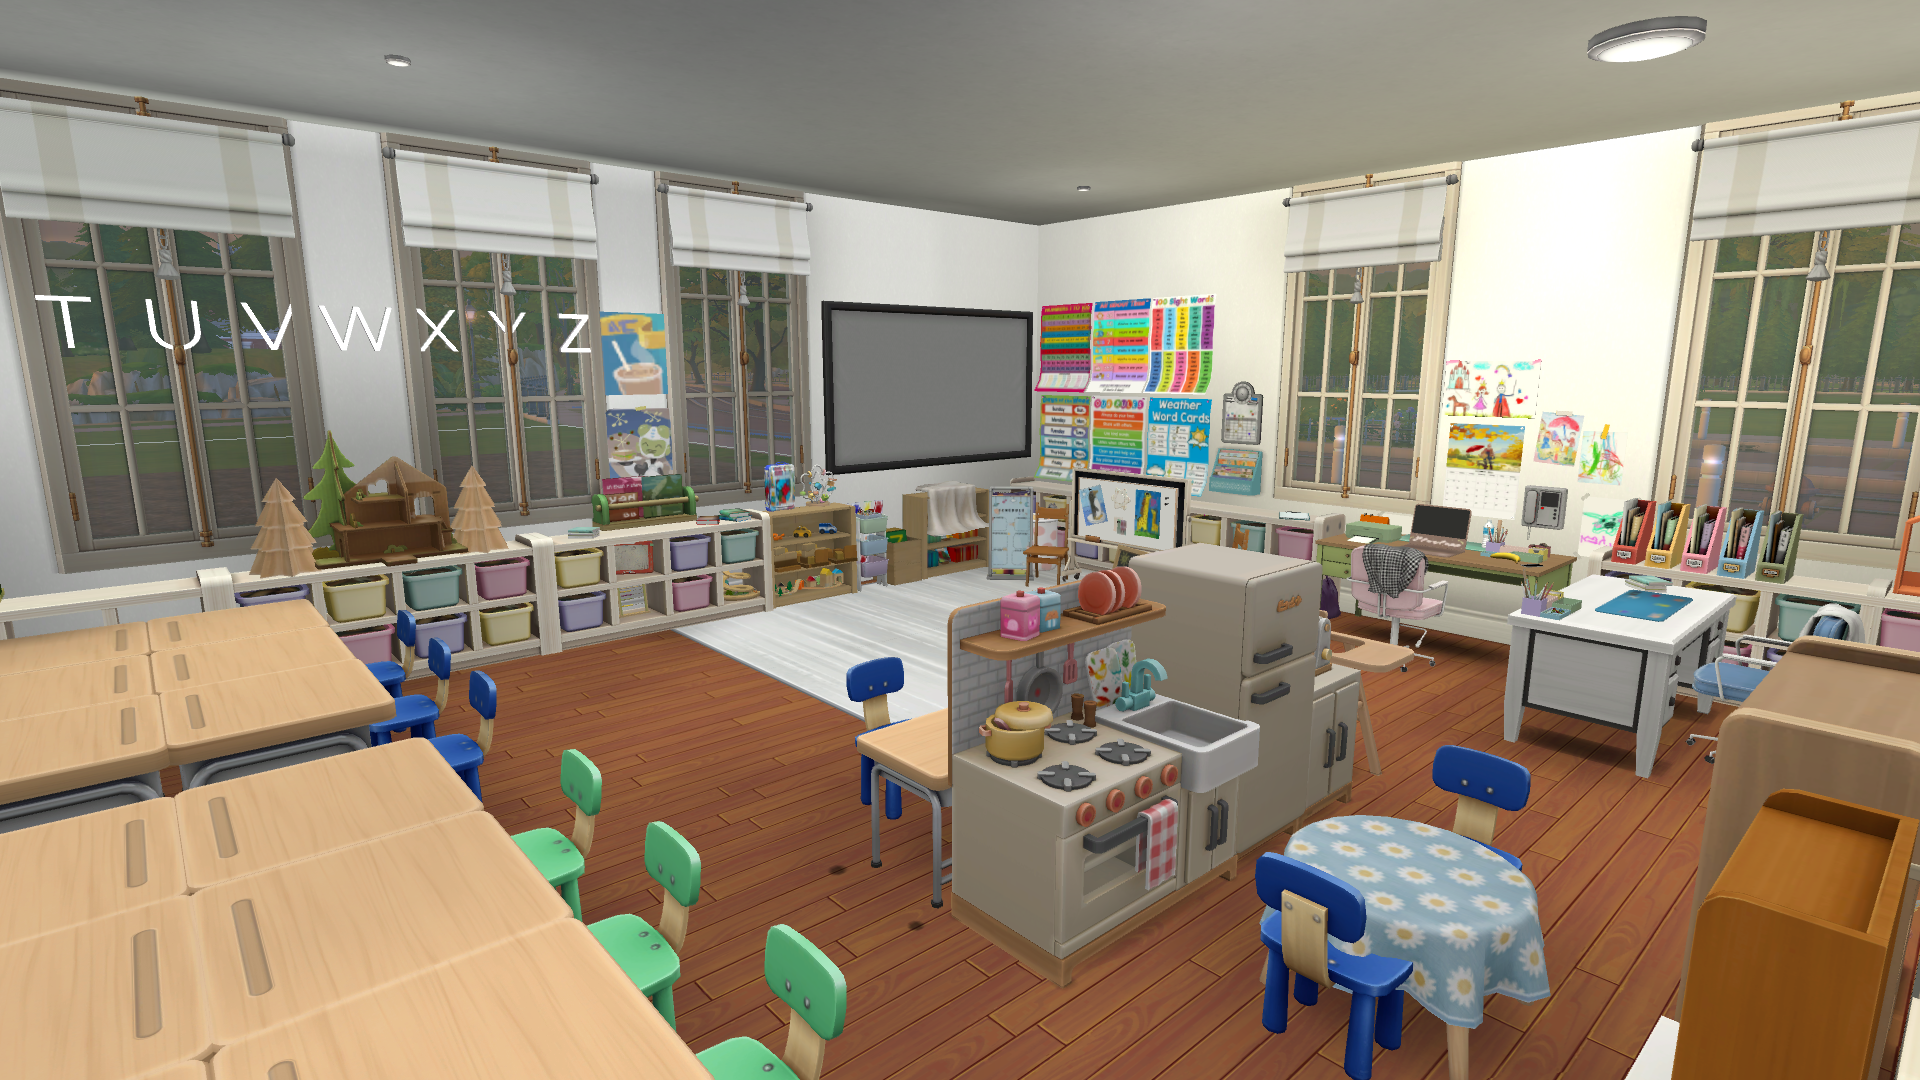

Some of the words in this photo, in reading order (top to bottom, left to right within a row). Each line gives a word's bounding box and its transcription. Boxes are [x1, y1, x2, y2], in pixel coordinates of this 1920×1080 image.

[1170, 297, 1188, 306] Sight
[35, 295, 91, 348] T
[146, 299, 201, 350] U
[241, 303, 292, 350] V
[319, 305, 392, 351] W
[417, 309, 458, 352] X
[487, 311, 526, 334] Y
[559, 314, 591, 352] Z
[1094, 399, 1112, 408] OUR
[1115, 400, 1144, 409] RULES
[1159, 400, 1201, 410] Weather
[1152, 411, 1178, 422] Word
[1181, 412, 1210, 423] Cards
